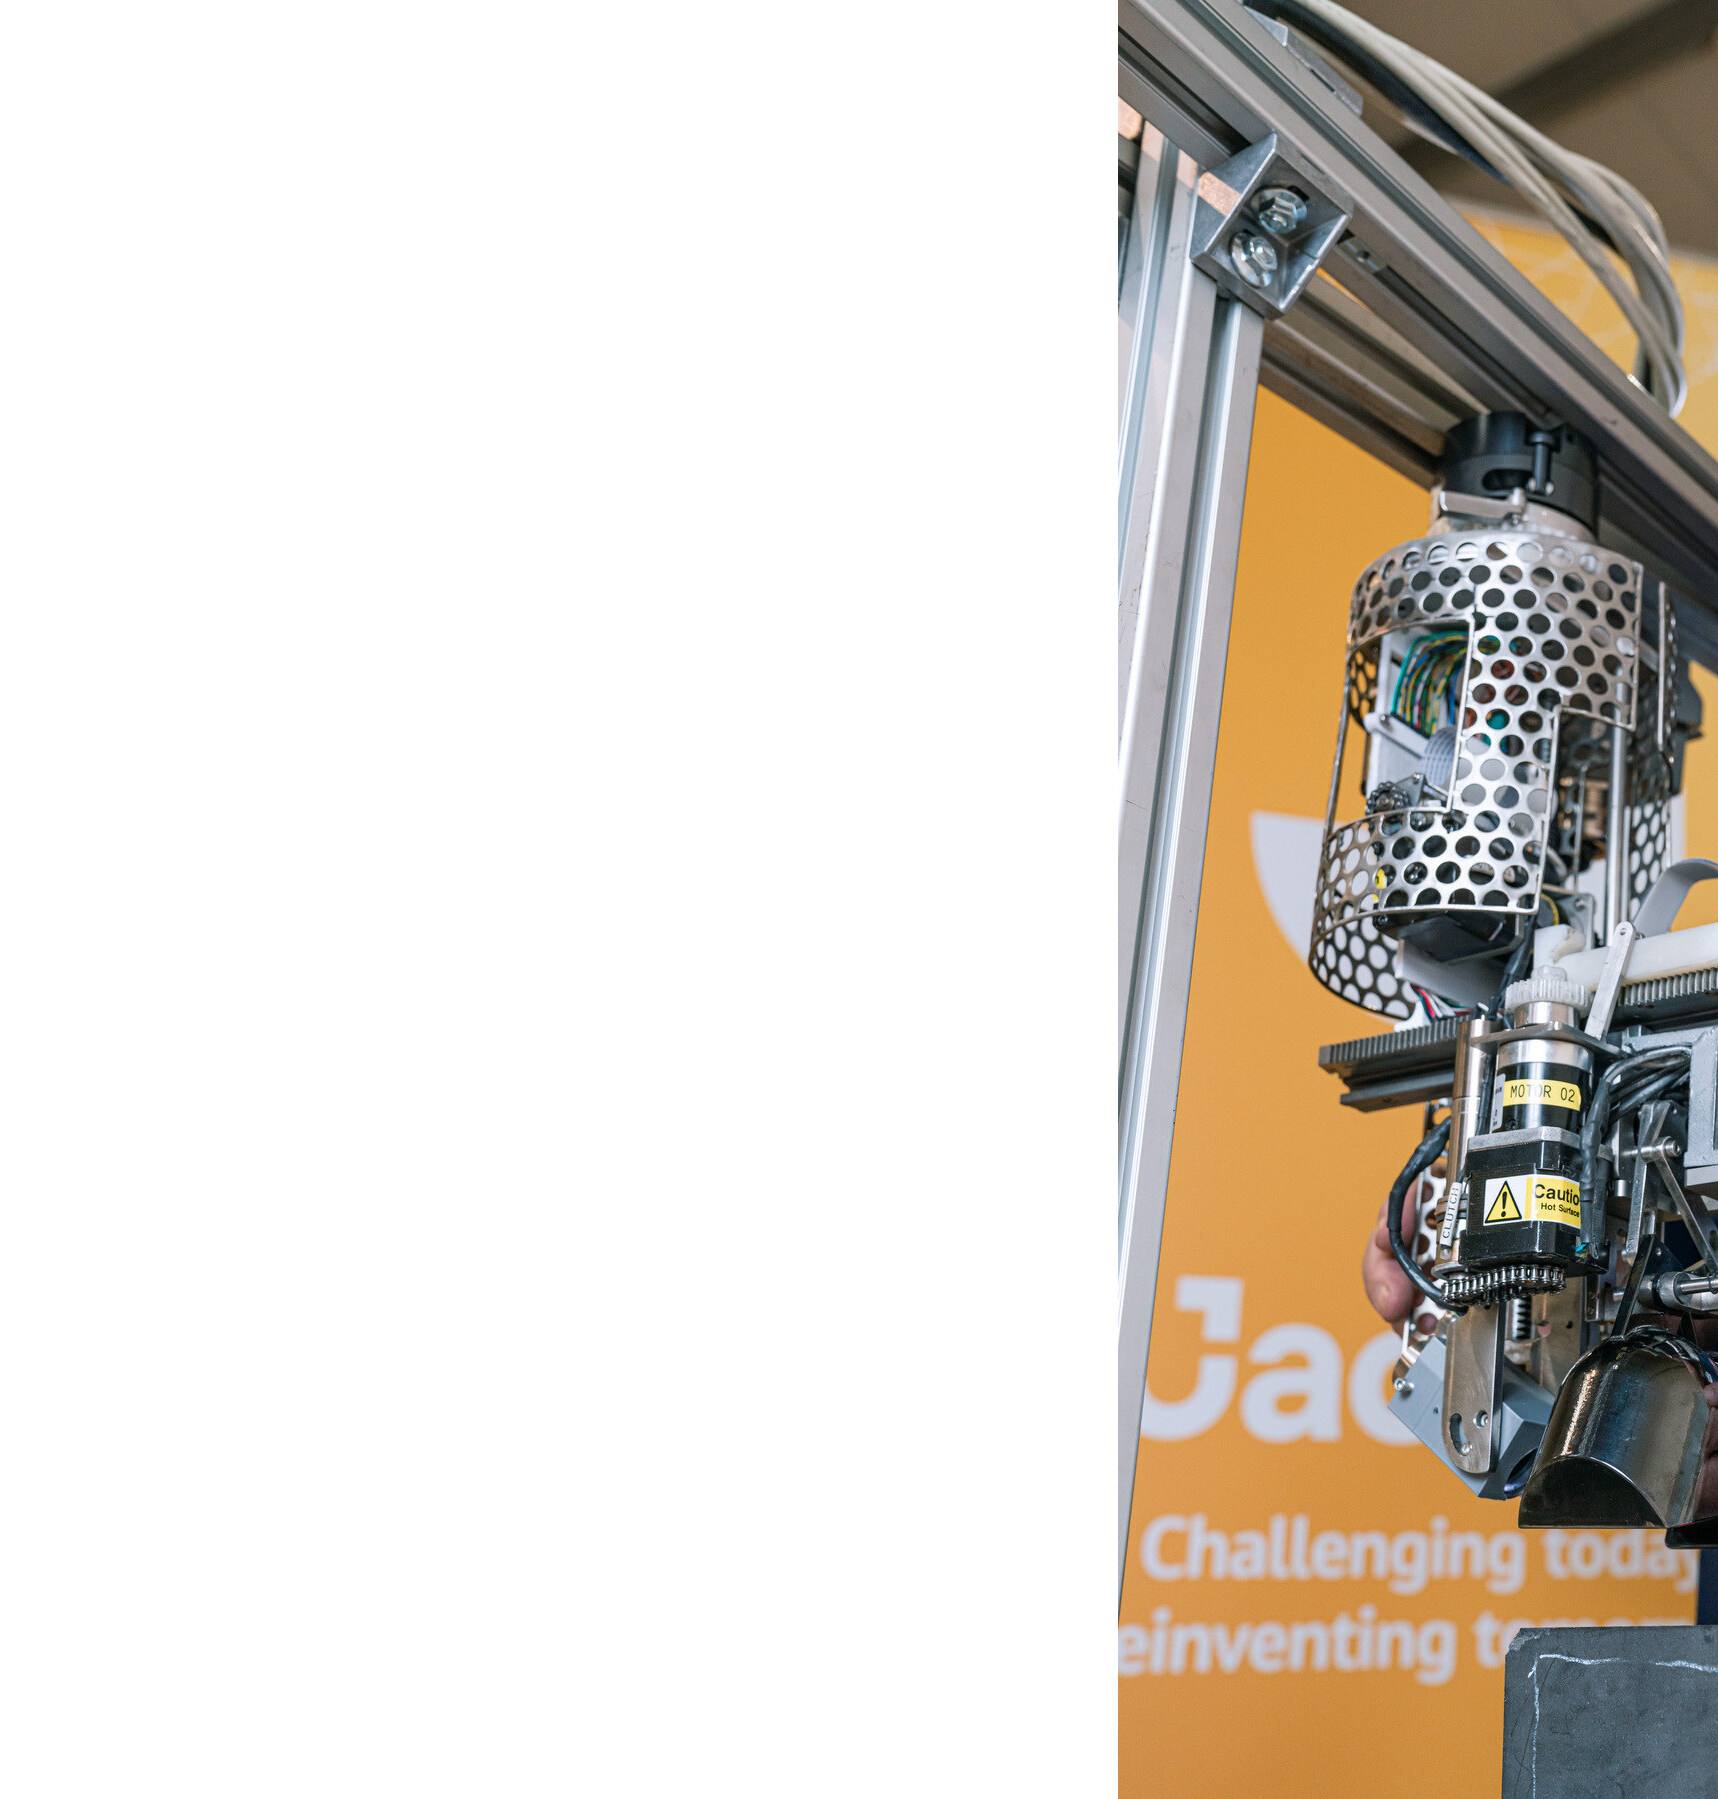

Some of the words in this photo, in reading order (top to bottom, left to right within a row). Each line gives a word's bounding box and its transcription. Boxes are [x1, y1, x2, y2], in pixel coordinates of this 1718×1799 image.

[1510, 1084, 1552, 1099] MOTOR
[1560, 1087, 1576, 1103] 02
[1535, 1183, 1580, 1206] Cautio
[1442, 1187, 1459, 1239] CLUTCH
[1541, 1202, 1556, 1211] Hot
[1558, 1204, 1580, 1218] Surface
[1139, 1513, 1524, 1595] Challenging
